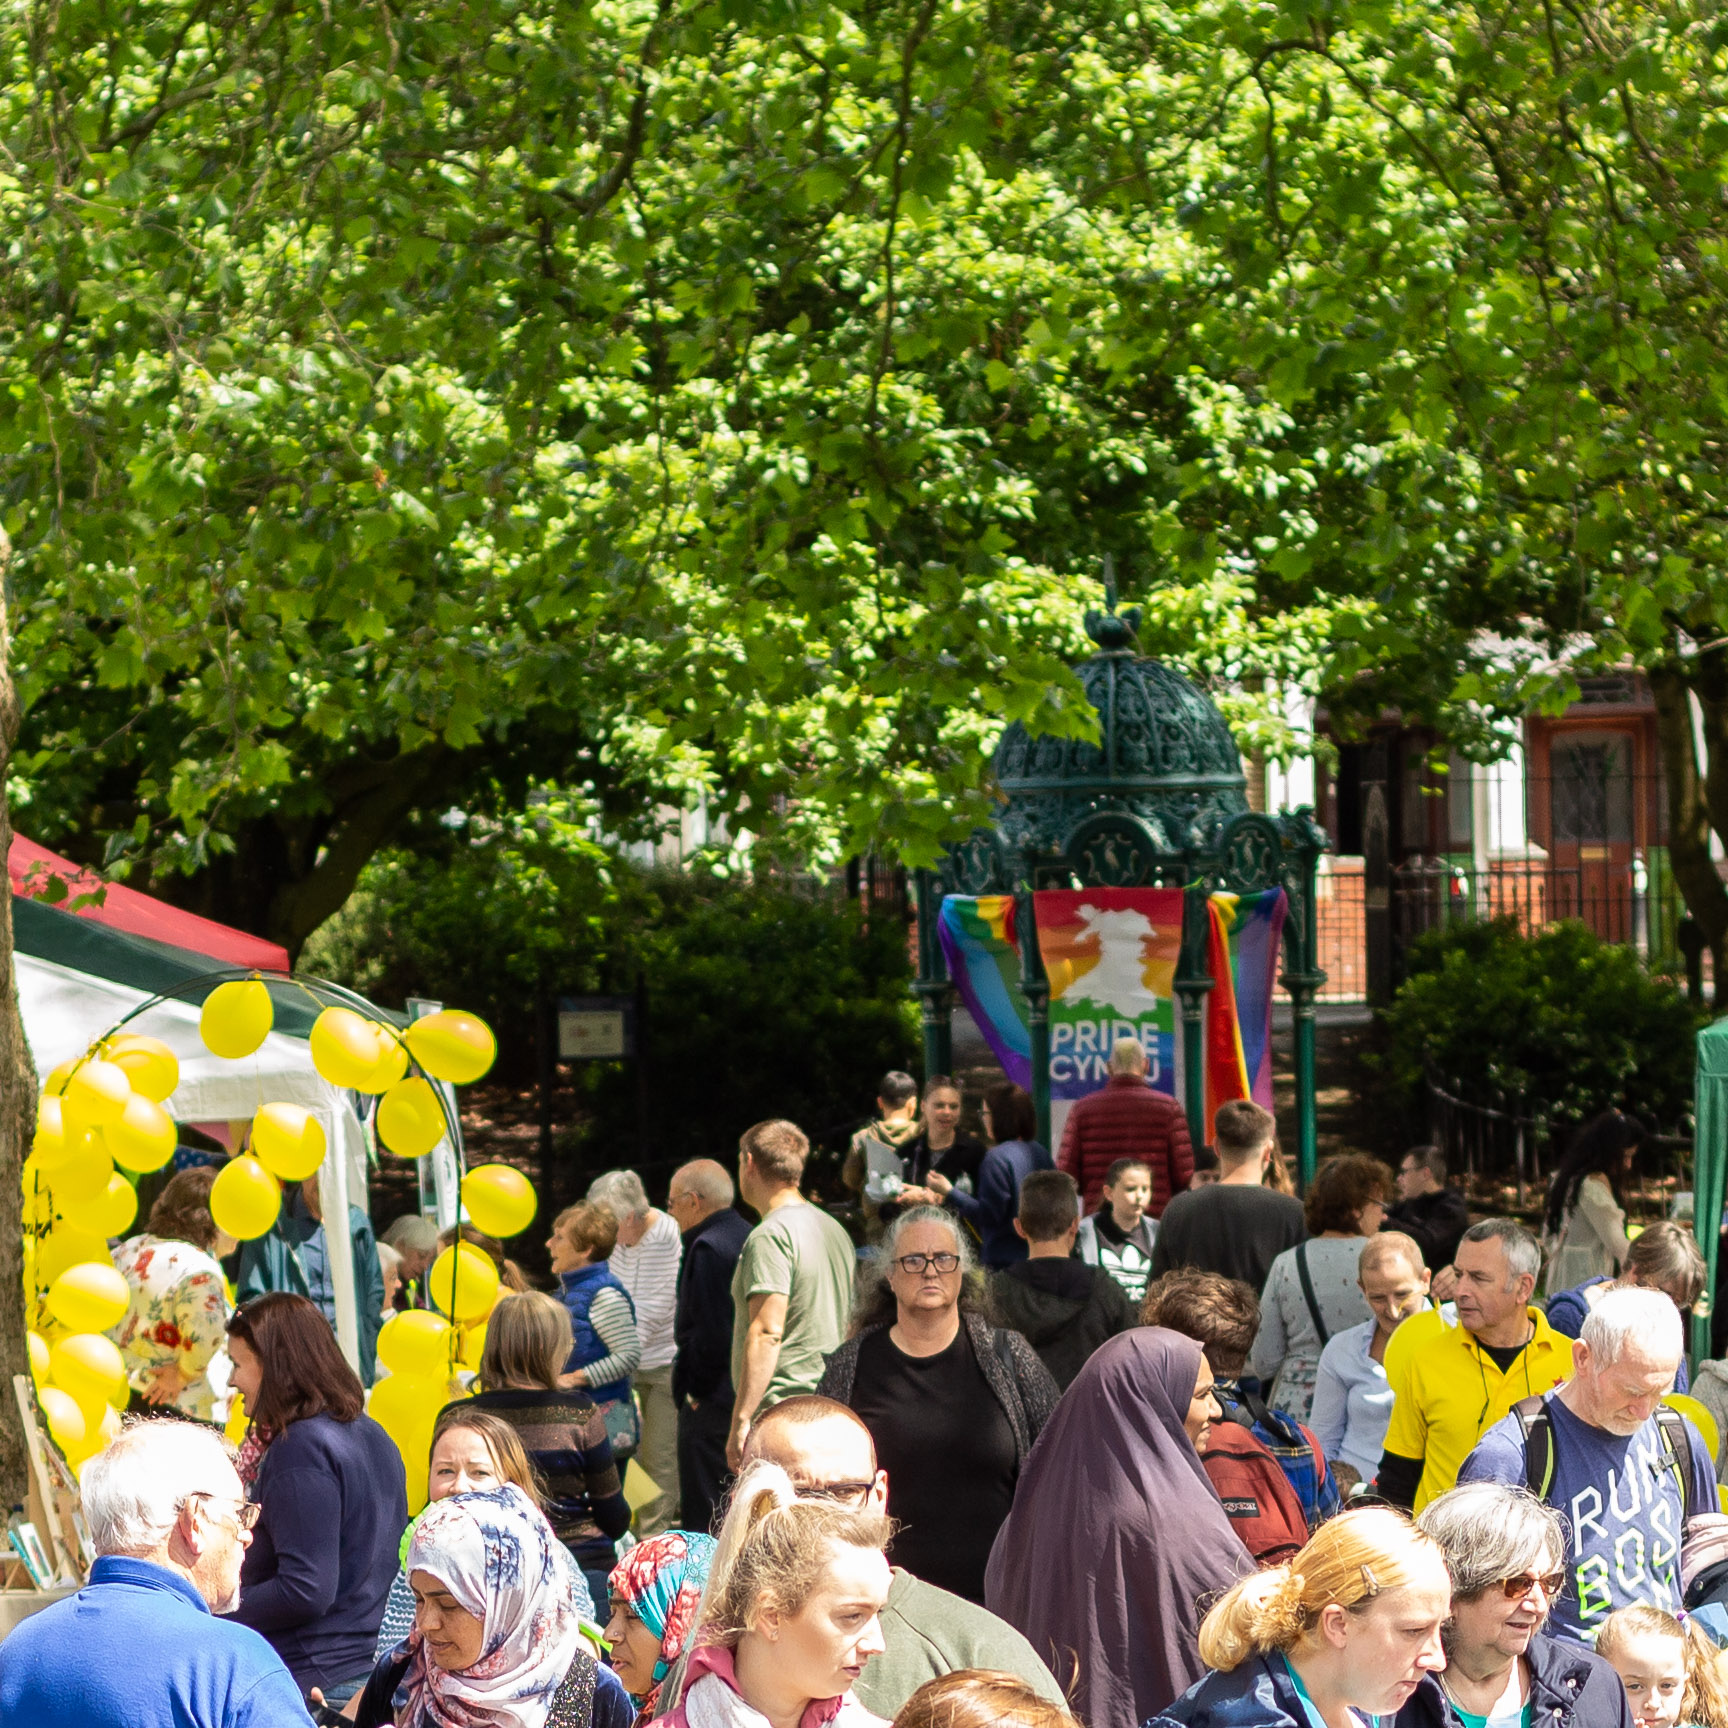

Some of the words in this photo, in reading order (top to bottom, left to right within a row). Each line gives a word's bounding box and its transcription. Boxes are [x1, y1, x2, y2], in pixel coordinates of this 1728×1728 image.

[1049, 1055, 1160, 1082] CYMU
[1051, 1019, 1160, 1055] PRIDE
[1571, 1430, 1667, 1557] RUN
[1576, 1498, 1677, 1620] BOS
